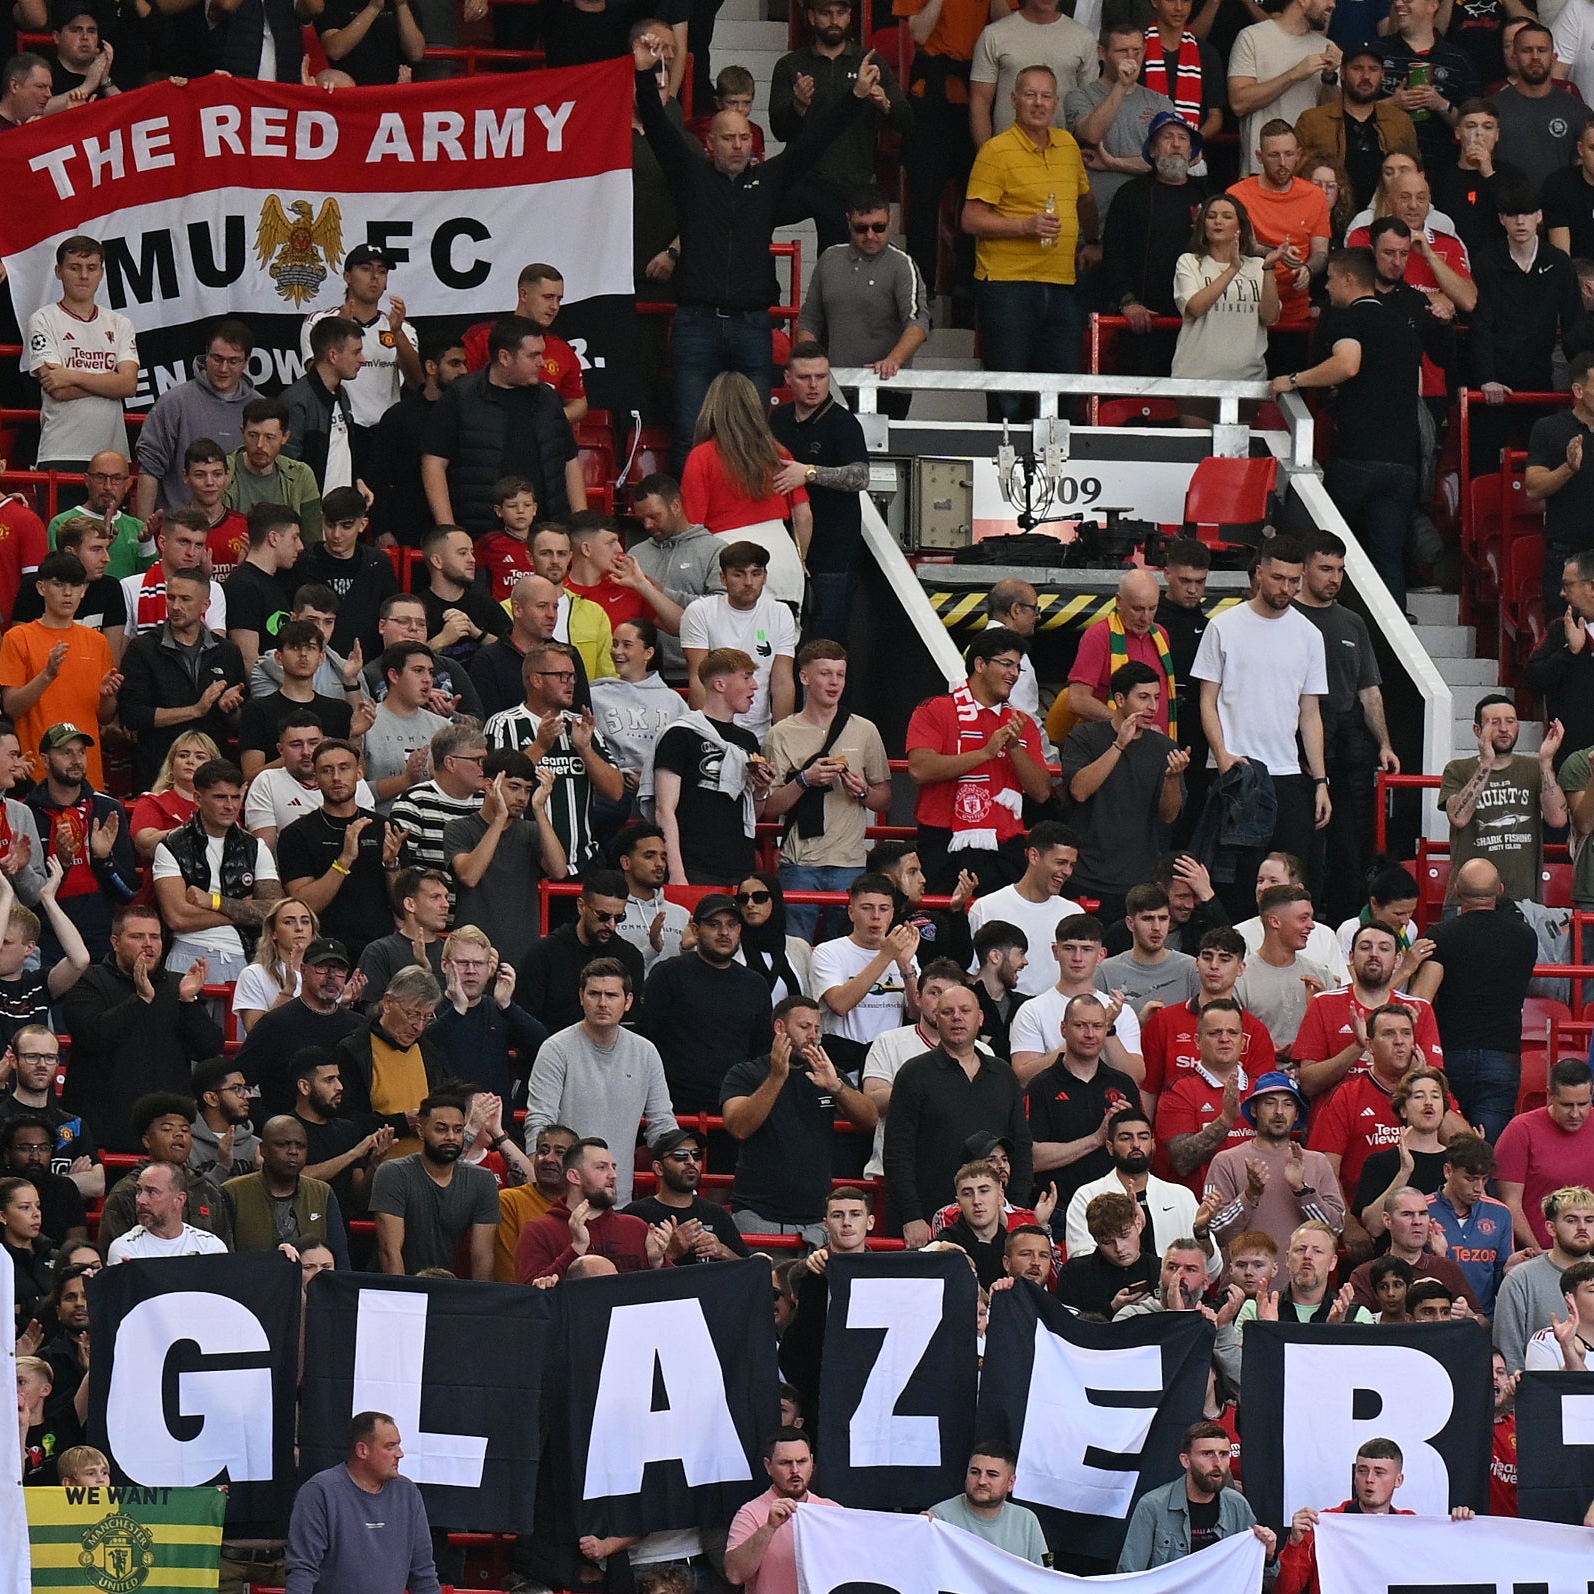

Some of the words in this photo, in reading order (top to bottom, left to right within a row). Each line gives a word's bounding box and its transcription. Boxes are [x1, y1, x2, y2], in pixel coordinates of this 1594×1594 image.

[29, 116, 176, 200] THE
[200, 105, 339, 160] RED
[365, 101, 576, 163] ARMY
[101, 216, 245, 310] MU
[71, 347, 104, 360] Team
[64, 357, 105, 371] Viewer
[1003, 476, 1103, 504] W209
[960, 813, 988, 823] UNITED
[1476, 836, 1505, 847] SHARK
[1506, 833, 1532, 846] FISHING
[65, 1487, 100, 1505] WE
[107, 1487, 173, 1505] WANT
[87, 1516, 147, 1547] MANCHESTER
[98, 1576, 139, 1592] UNITED
